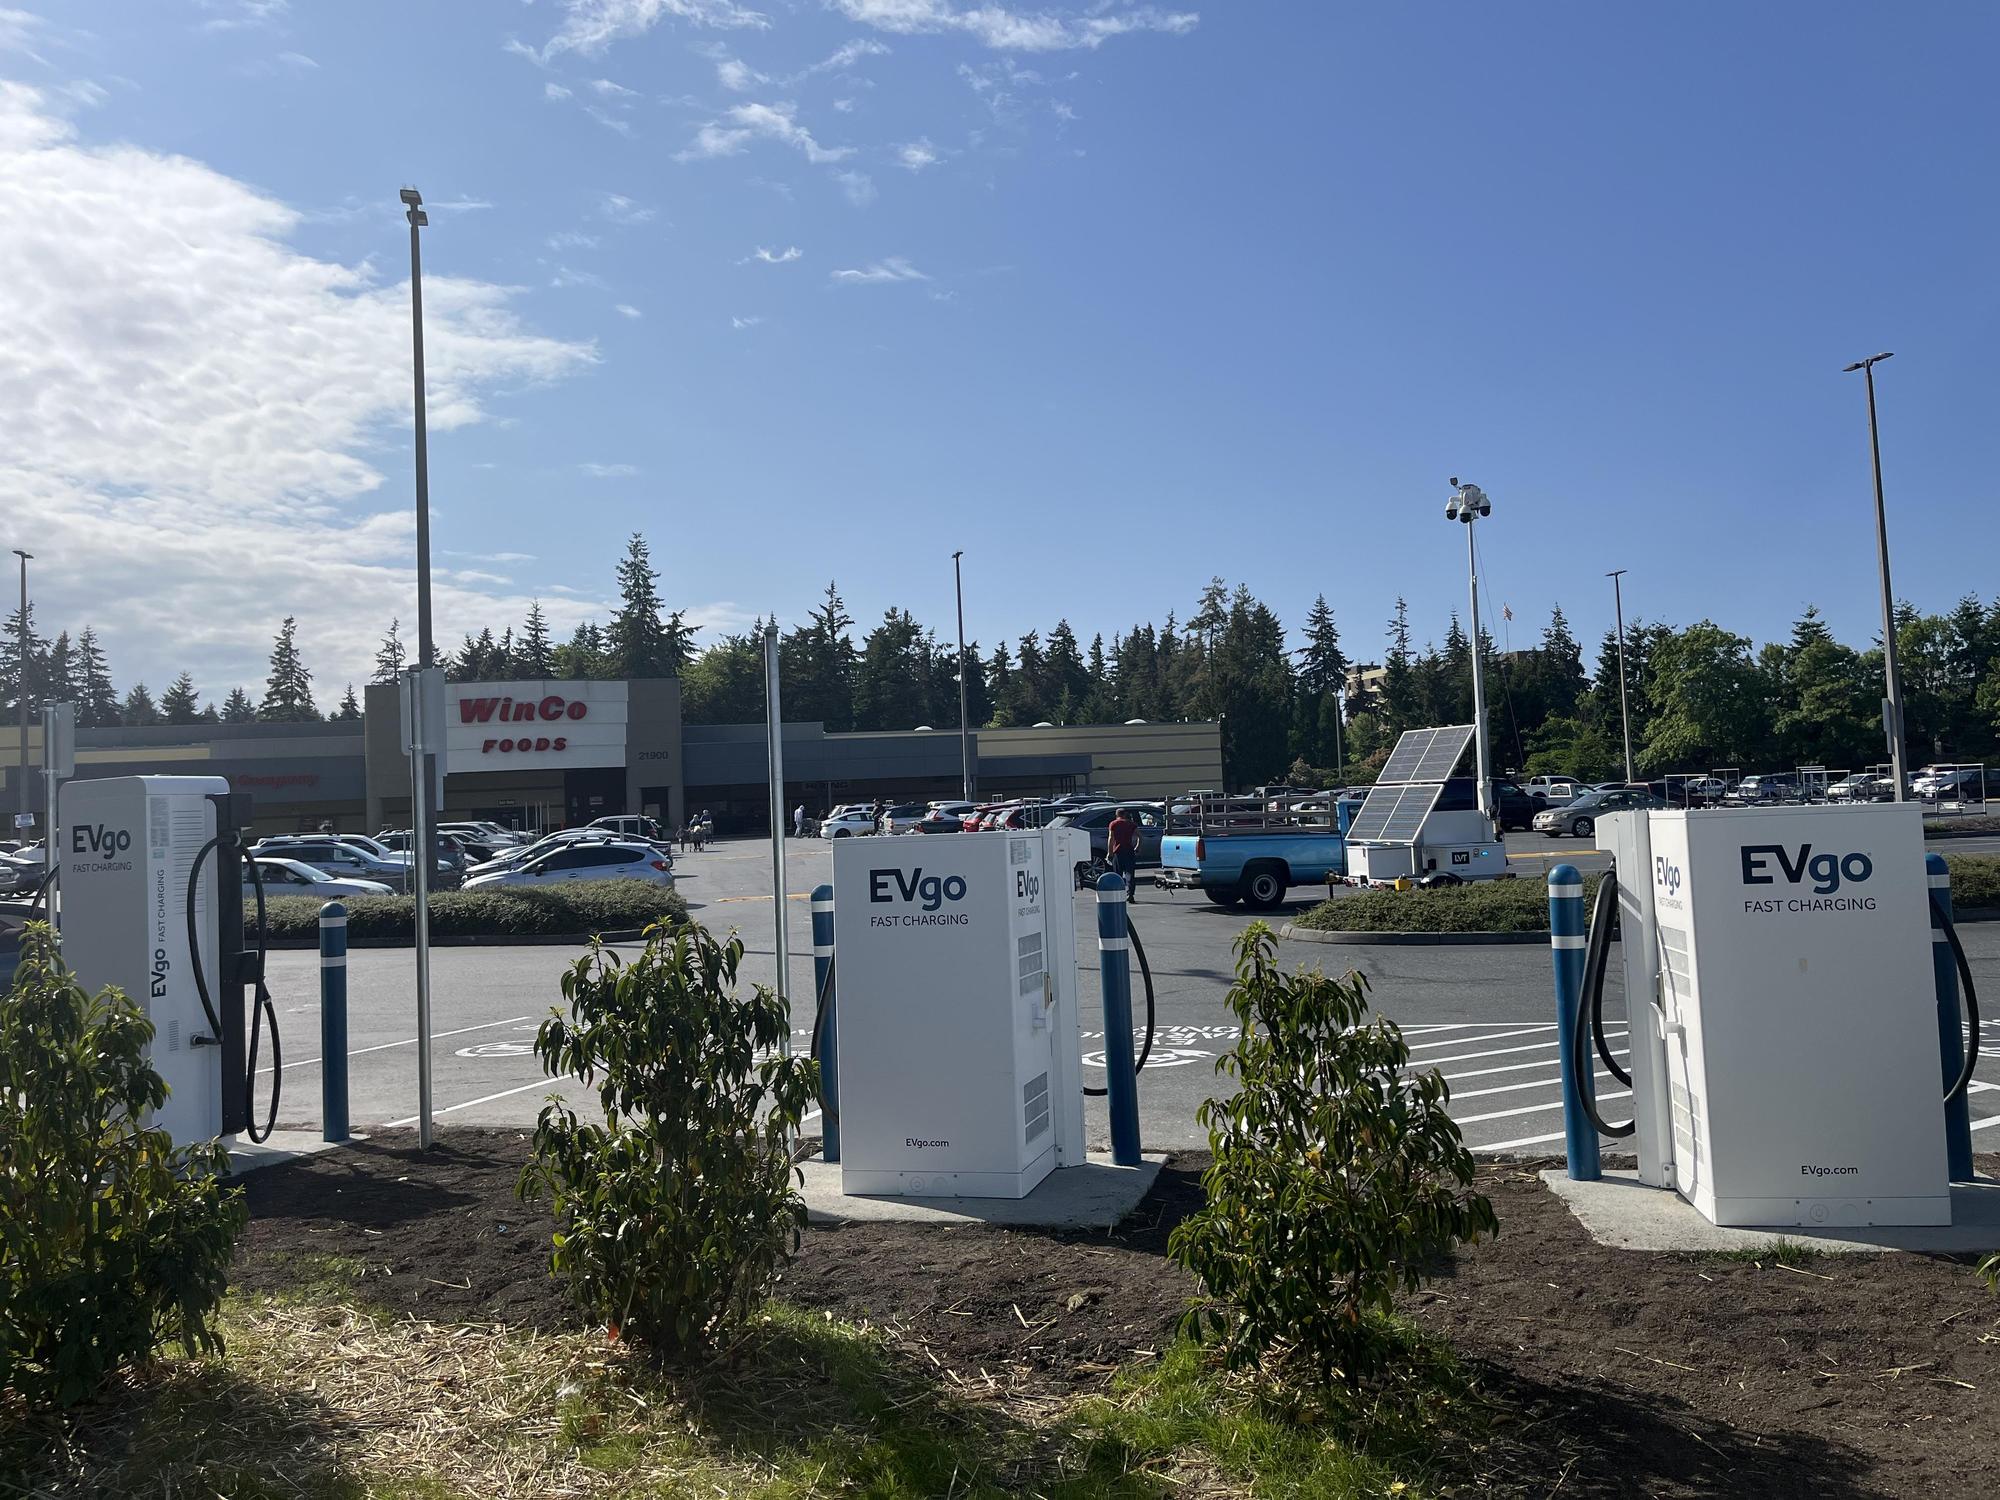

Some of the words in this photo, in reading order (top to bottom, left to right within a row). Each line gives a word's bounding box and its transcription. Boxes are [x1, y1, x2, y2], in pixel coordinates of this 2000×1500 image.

[459, 695, 587, 723] WinCo
[481, 737, 567, 753] FOODS
[638, 751, 669, 760] 21900
[72, 823, 131, 860] EVgo
[72, 863, 91, 873] FAST
[91, 861, 132, 872] CHARGING
[1454, 854, 1468, 863] LVT
[1741, 844, 1873, 895] EVgo
[1017, 870, 1039, 904] EVgo
[1656, 856, 1681, 896] EVgo
[157, 869, 165, 919] CHARGING
[869, 867, 967, 911] EVgo
[1745, 900, 1783, 913] FAST
[1788, 897, 1876, 912] CHARGING
[158, 920, 166, 942] FAST
[870, 916, 900, 927] FAST
[902, 913, 969, 926] CHARGING
[151, 948, 170, 998] EVgo
[906, 1138, 949, 1149] EVgo.com
[1801, 1165, 1858, 1177] EVgo.com
